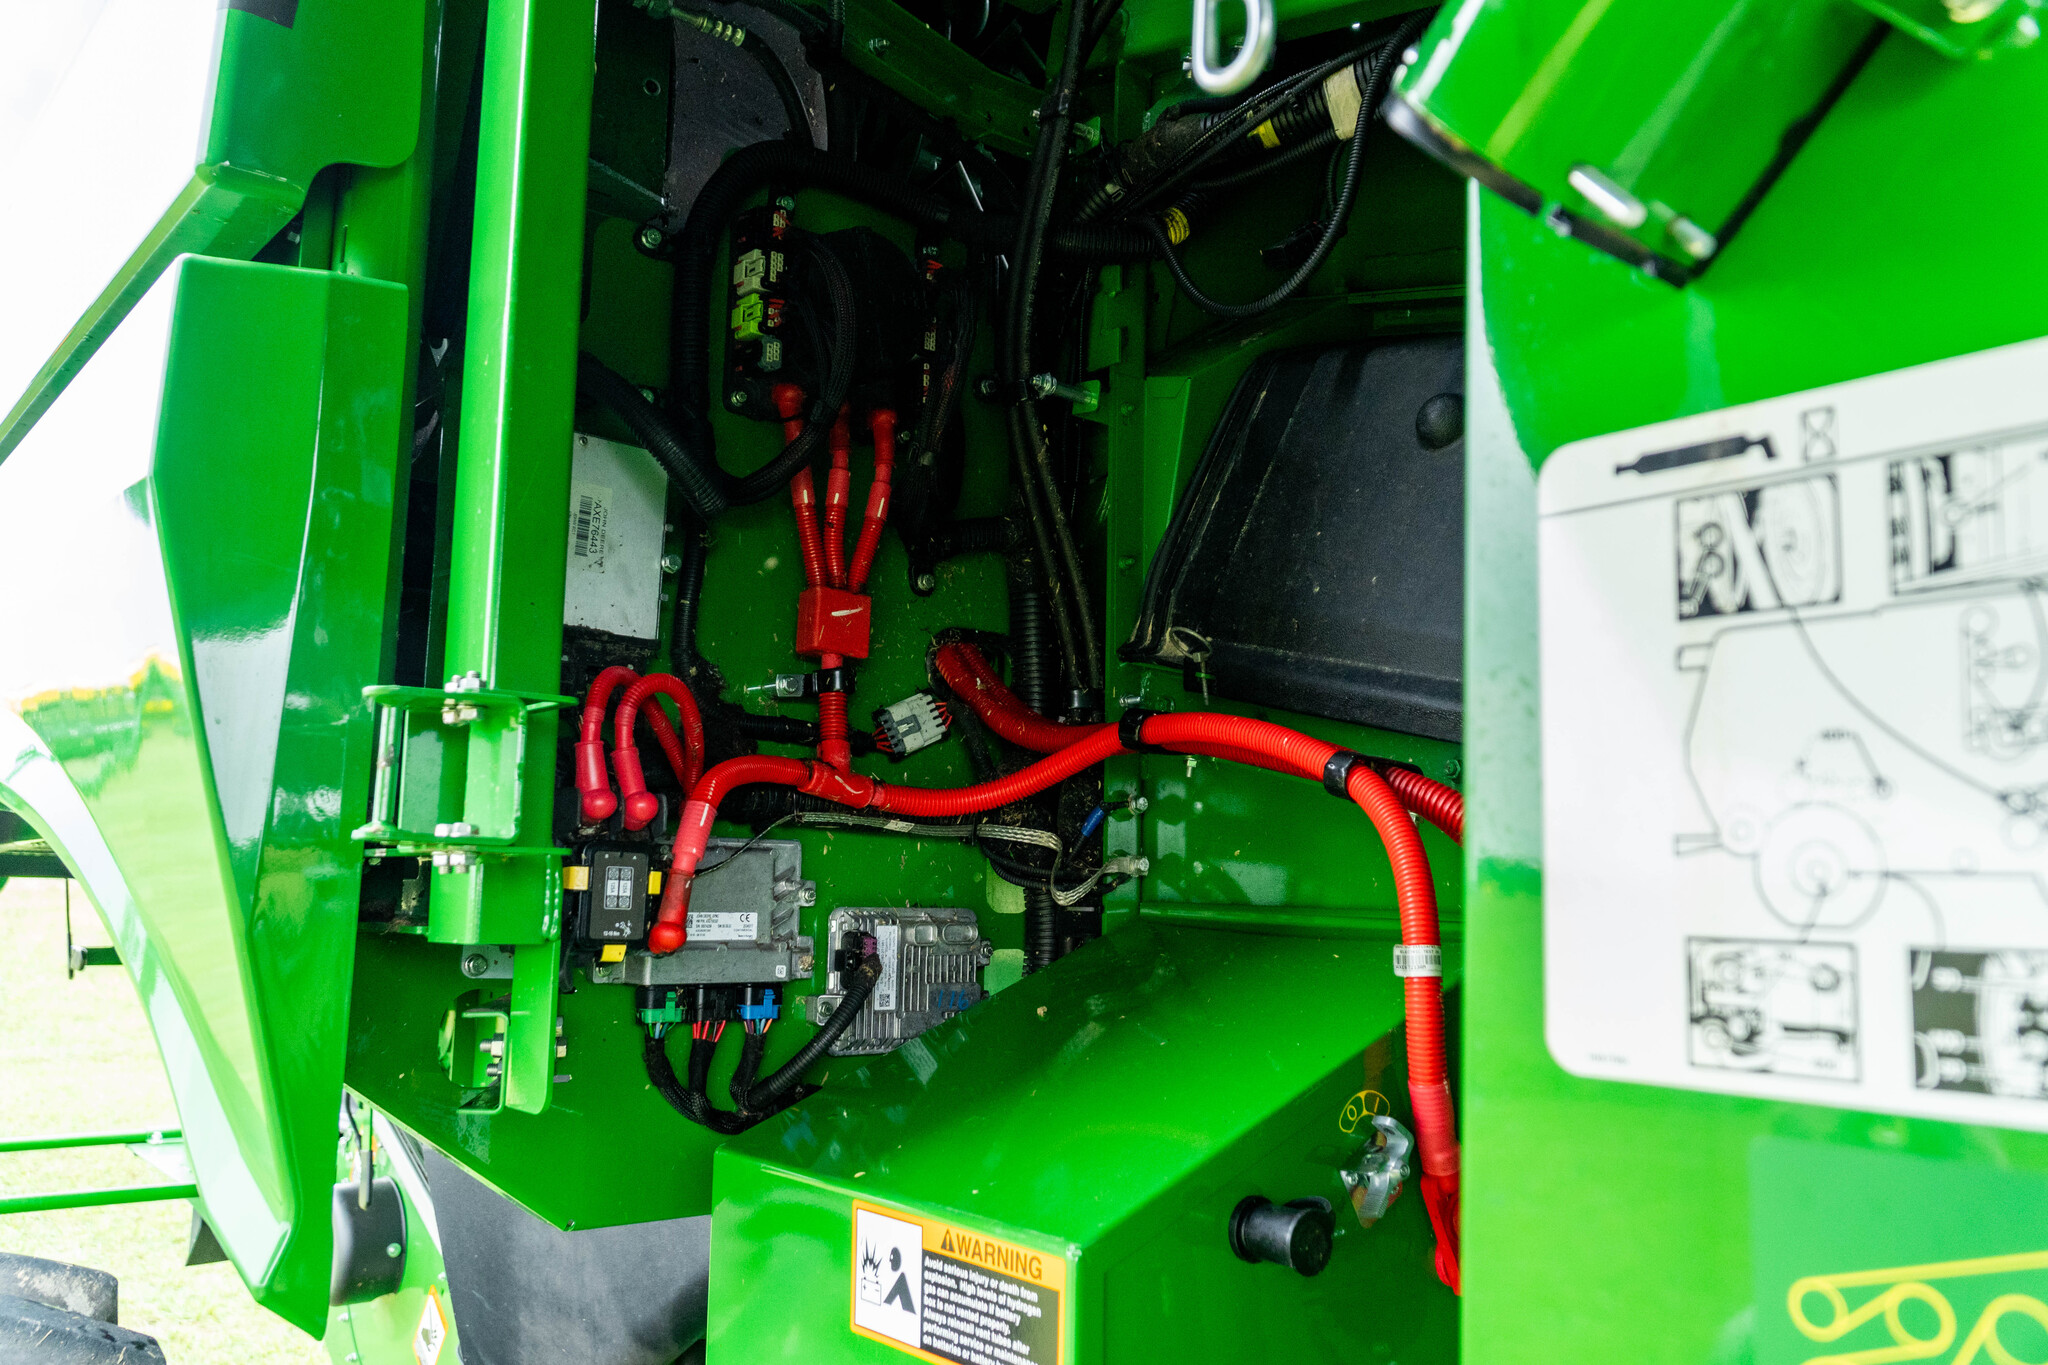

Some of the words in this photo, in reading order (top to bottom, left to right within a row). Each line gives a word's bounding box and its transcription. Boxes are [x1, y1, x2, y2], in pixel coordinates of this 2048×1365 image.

[588, 501, 602, 554] AXE76443
[938, 988, 969, 1010] 116
[956, 1232, 1042, 1280] WARNING
[924, 1255, 943, 1271] Avoid
[943, 1263, 969, 1280] serious
[969, 1269, 989, 1289] injury
[989, 1278, 999, 1290] or
[999, 1280, 1019, 1296] death
[1020, 1286, 1038, 1303] from
[924, 1270, 957, 1290] explosion.
[959, 1279, 976, 1296] High
[976, 1285, 997, 1303] levels
[997, 1294, 1006, 1306] of
[1006, 1295, 1041, 1318] hydrogen
[923, 1294, 936, 1308] box
[936, 1298, 943, 1311] is
[943, 1302, 955, 1315] not
[956, 1306, 979, 1323] vented
[980, 1314, 1010, 1336] properly.
[924, 1283, 936, 1296] gas
[936, 1287, 949, 1300] can
[949, 1291, 988, 1313] accumulate
[995, 1304, 1021, 1326] battery
[922, 1321, 959, 1345] performing
[959, 1334, 984, 1352] service
[984, 1343, 993, 1355] or
[922, 1334, 932, 1346] on
[932, 1336, 961, 1356] batteries
[961, 1348, 970, 1360] or
[923, 1307, 946, 1325] Always
[946, 1316, 974, 1334] reinstall
[975, 1326, 990, 1341] vent
[990, 1331, 1011, 1349] tubes
[1012, 1339, 1030, 1355] after
